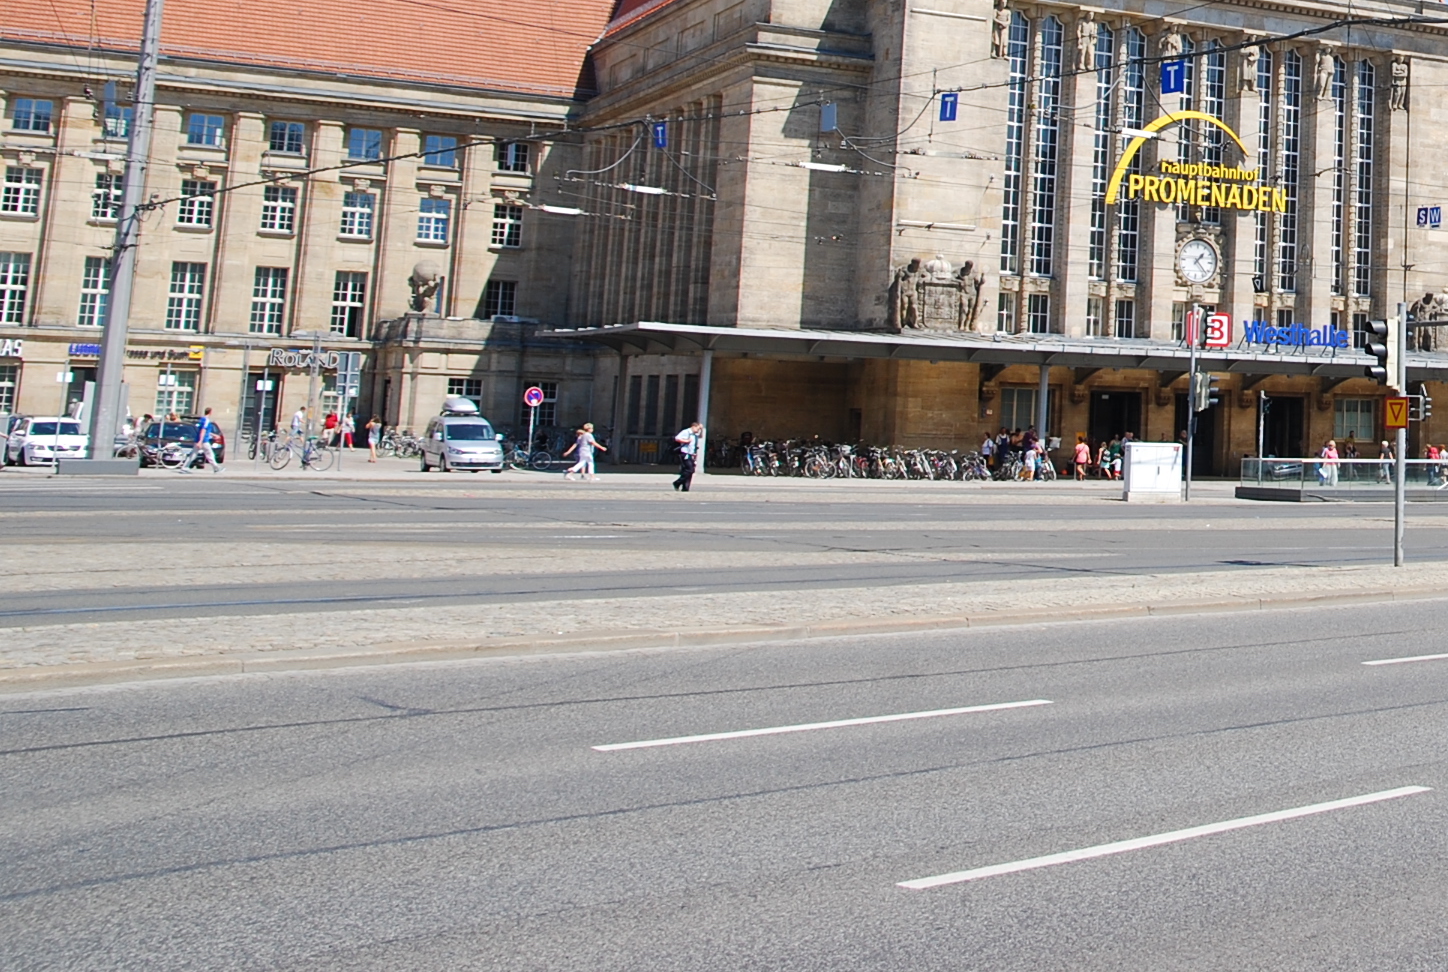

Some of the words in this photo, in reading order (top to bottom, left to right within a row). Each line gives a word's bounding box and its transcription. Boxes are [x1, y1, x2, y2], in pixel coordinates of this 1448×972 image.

[1166, 65, 1180, 89] T
[945, 96, 955, 118] T
[656, 126, 664, 145] T
[1129, 174, 1287, 212] PROMENADEN
[1419, 210, 1426, 223] S
[1430, 209, 1440, 223] W
[1243, 320, 1349, 348] Westhalle
